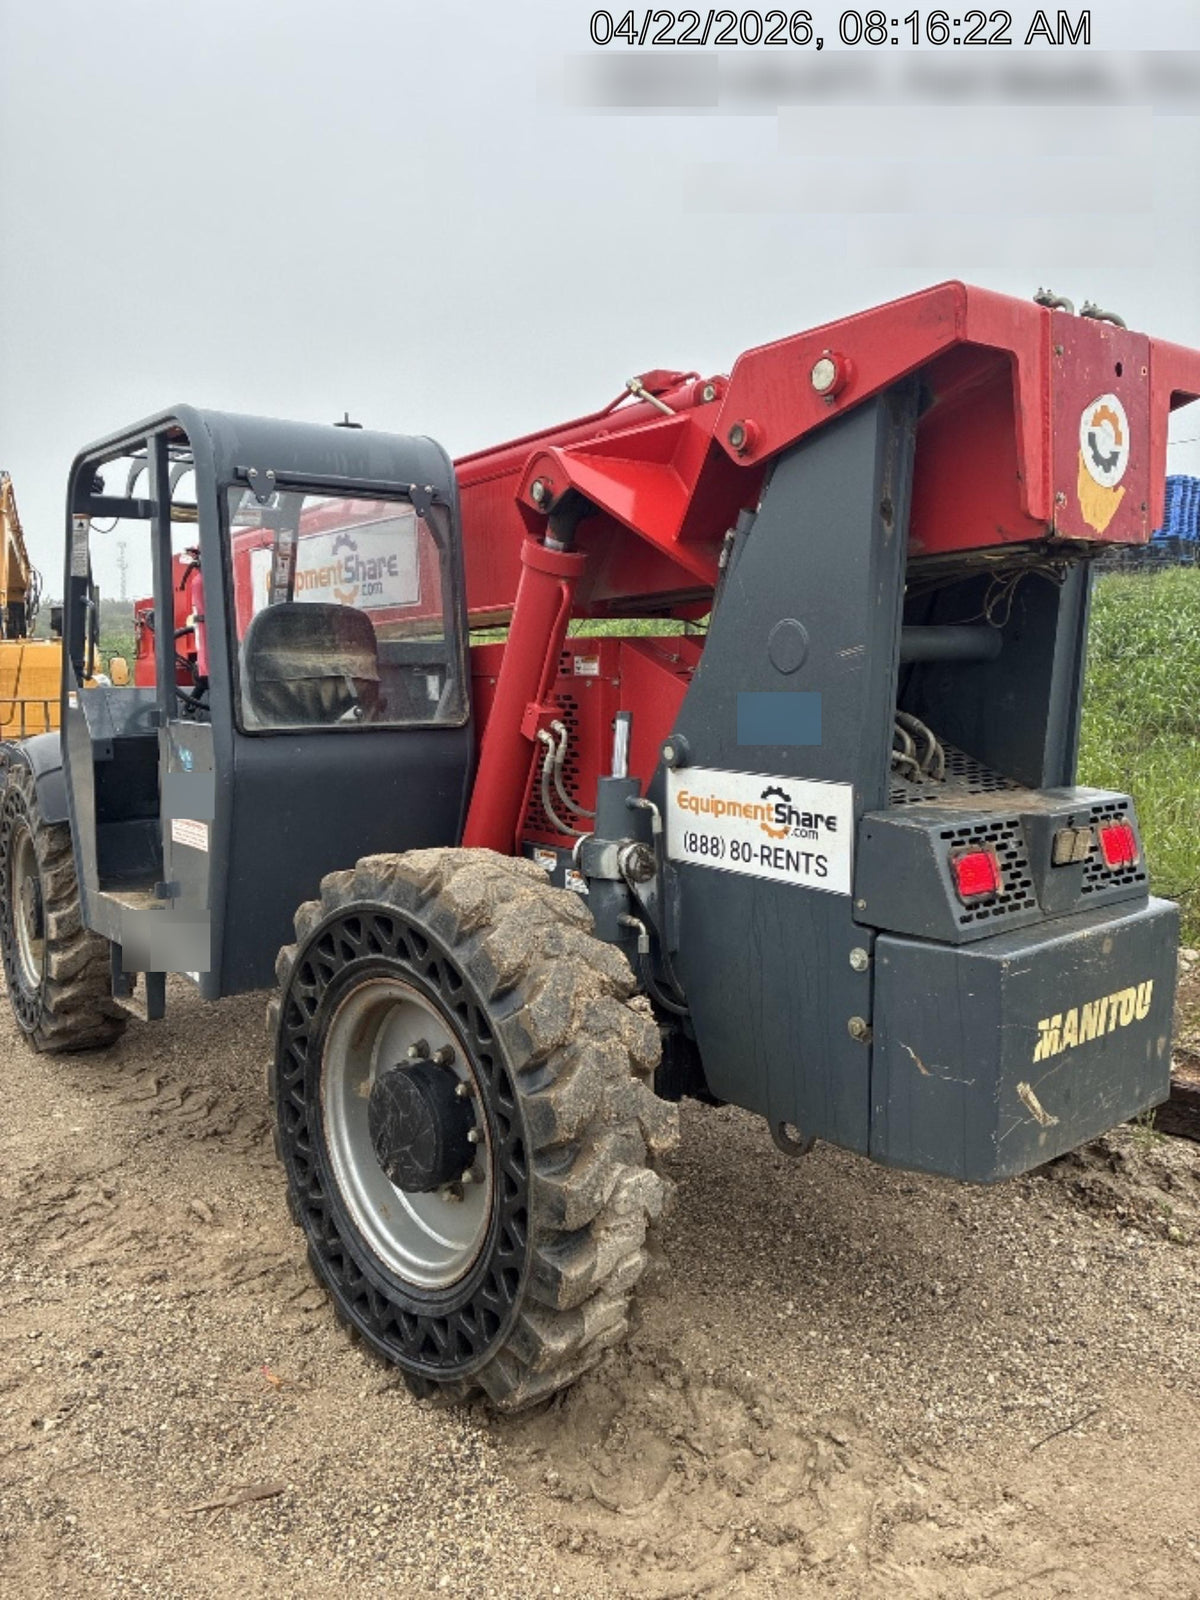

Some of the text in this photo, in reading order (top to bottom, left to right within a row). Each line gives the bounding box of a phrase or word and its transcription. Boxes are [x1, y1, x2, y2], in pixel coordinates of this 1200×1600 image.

[677, 790, 837, 832] EquipmentShare
[684, 830, 828, 877] (888) 80-RENTS
[790, 827, 819, 840] .com
[1032, 978, 1154, 1064] MANITOU
